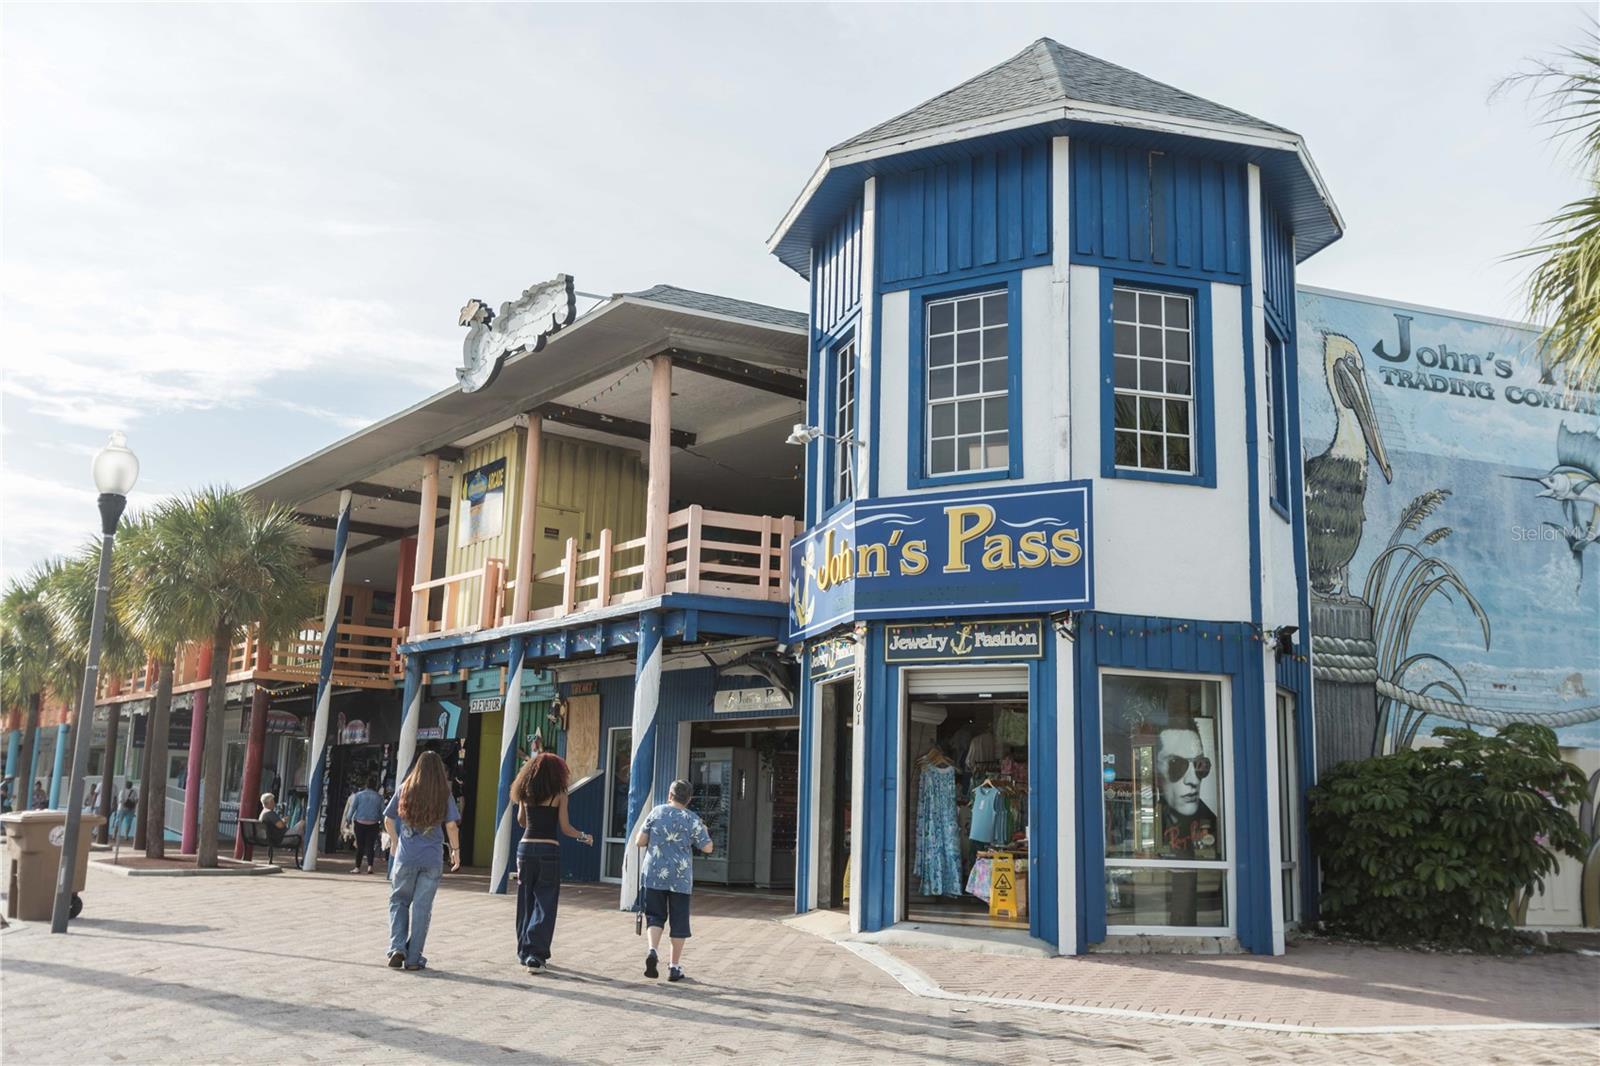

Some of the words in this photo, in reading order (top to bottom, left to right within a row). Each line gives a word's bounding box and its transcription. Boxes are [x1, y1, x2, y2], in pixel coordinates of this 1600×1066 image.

[1372, 314, 1513, 379] John's
[1379, 366, 1495, 400] TRADING
[816, 528, 929, 592] John's
[943, 503, 1082, 574] Pass
[889, 634, 948, 652] Jewelry
[974, 631, 1038, 647] Fashion
